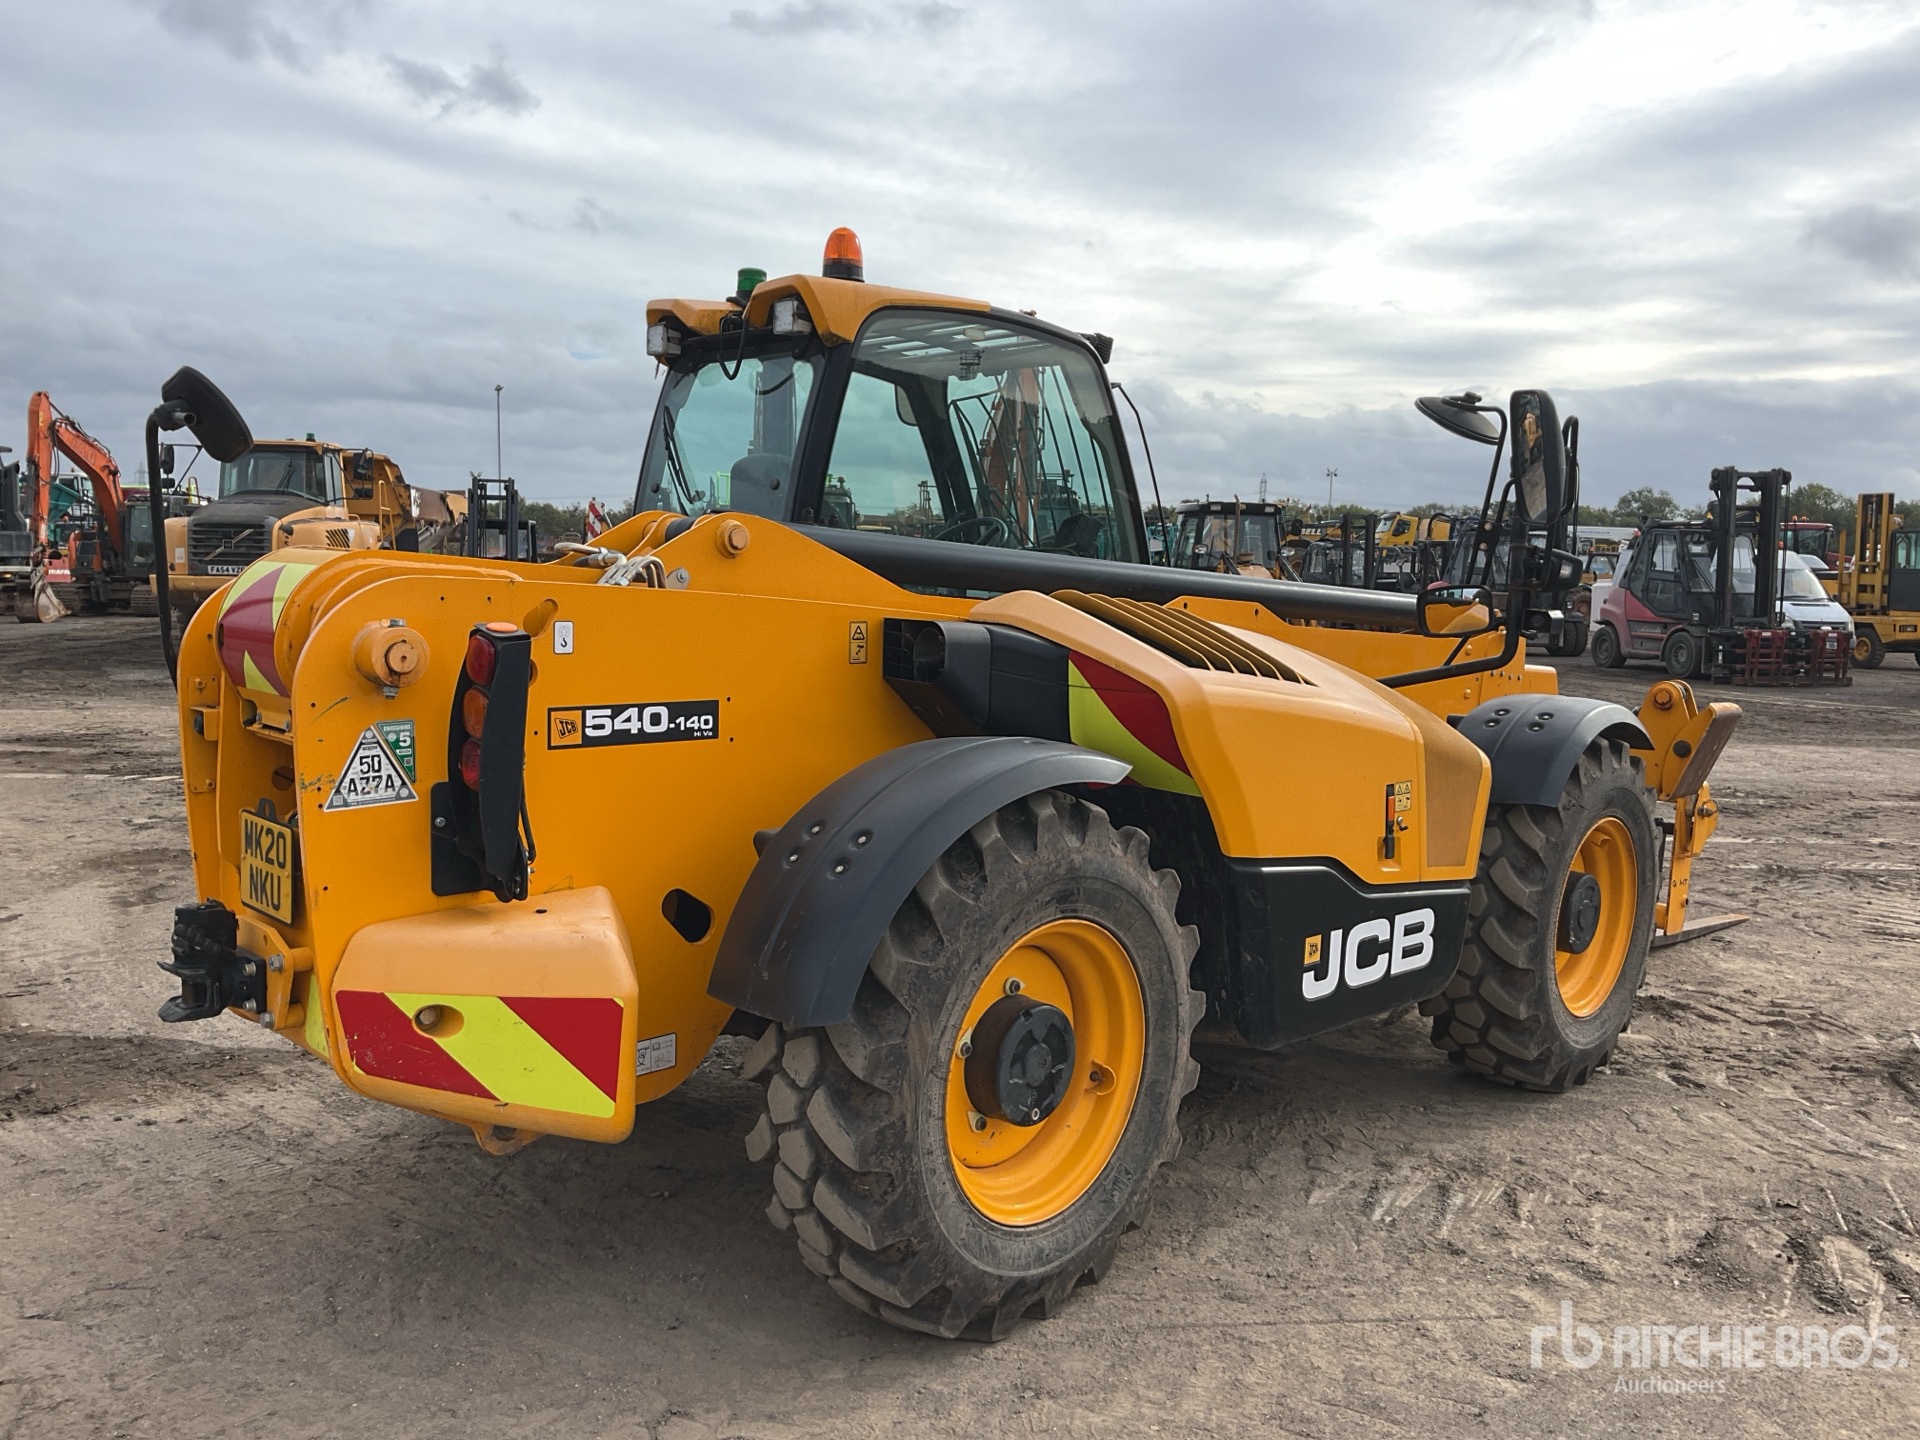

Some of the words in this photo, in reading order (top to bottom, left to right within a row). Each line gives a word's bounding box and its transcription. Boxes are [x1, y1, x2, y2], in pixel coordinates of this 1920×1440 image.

[398, 731, 411, 747] 5
[559, 720, 577, 737] JCB
[585, 705, 713, 737] 540-140
[244, 818, 287, 870] MK20
[249, 863, 281, 912] NKU
[1302, 907, 1436, 1000] JCB
